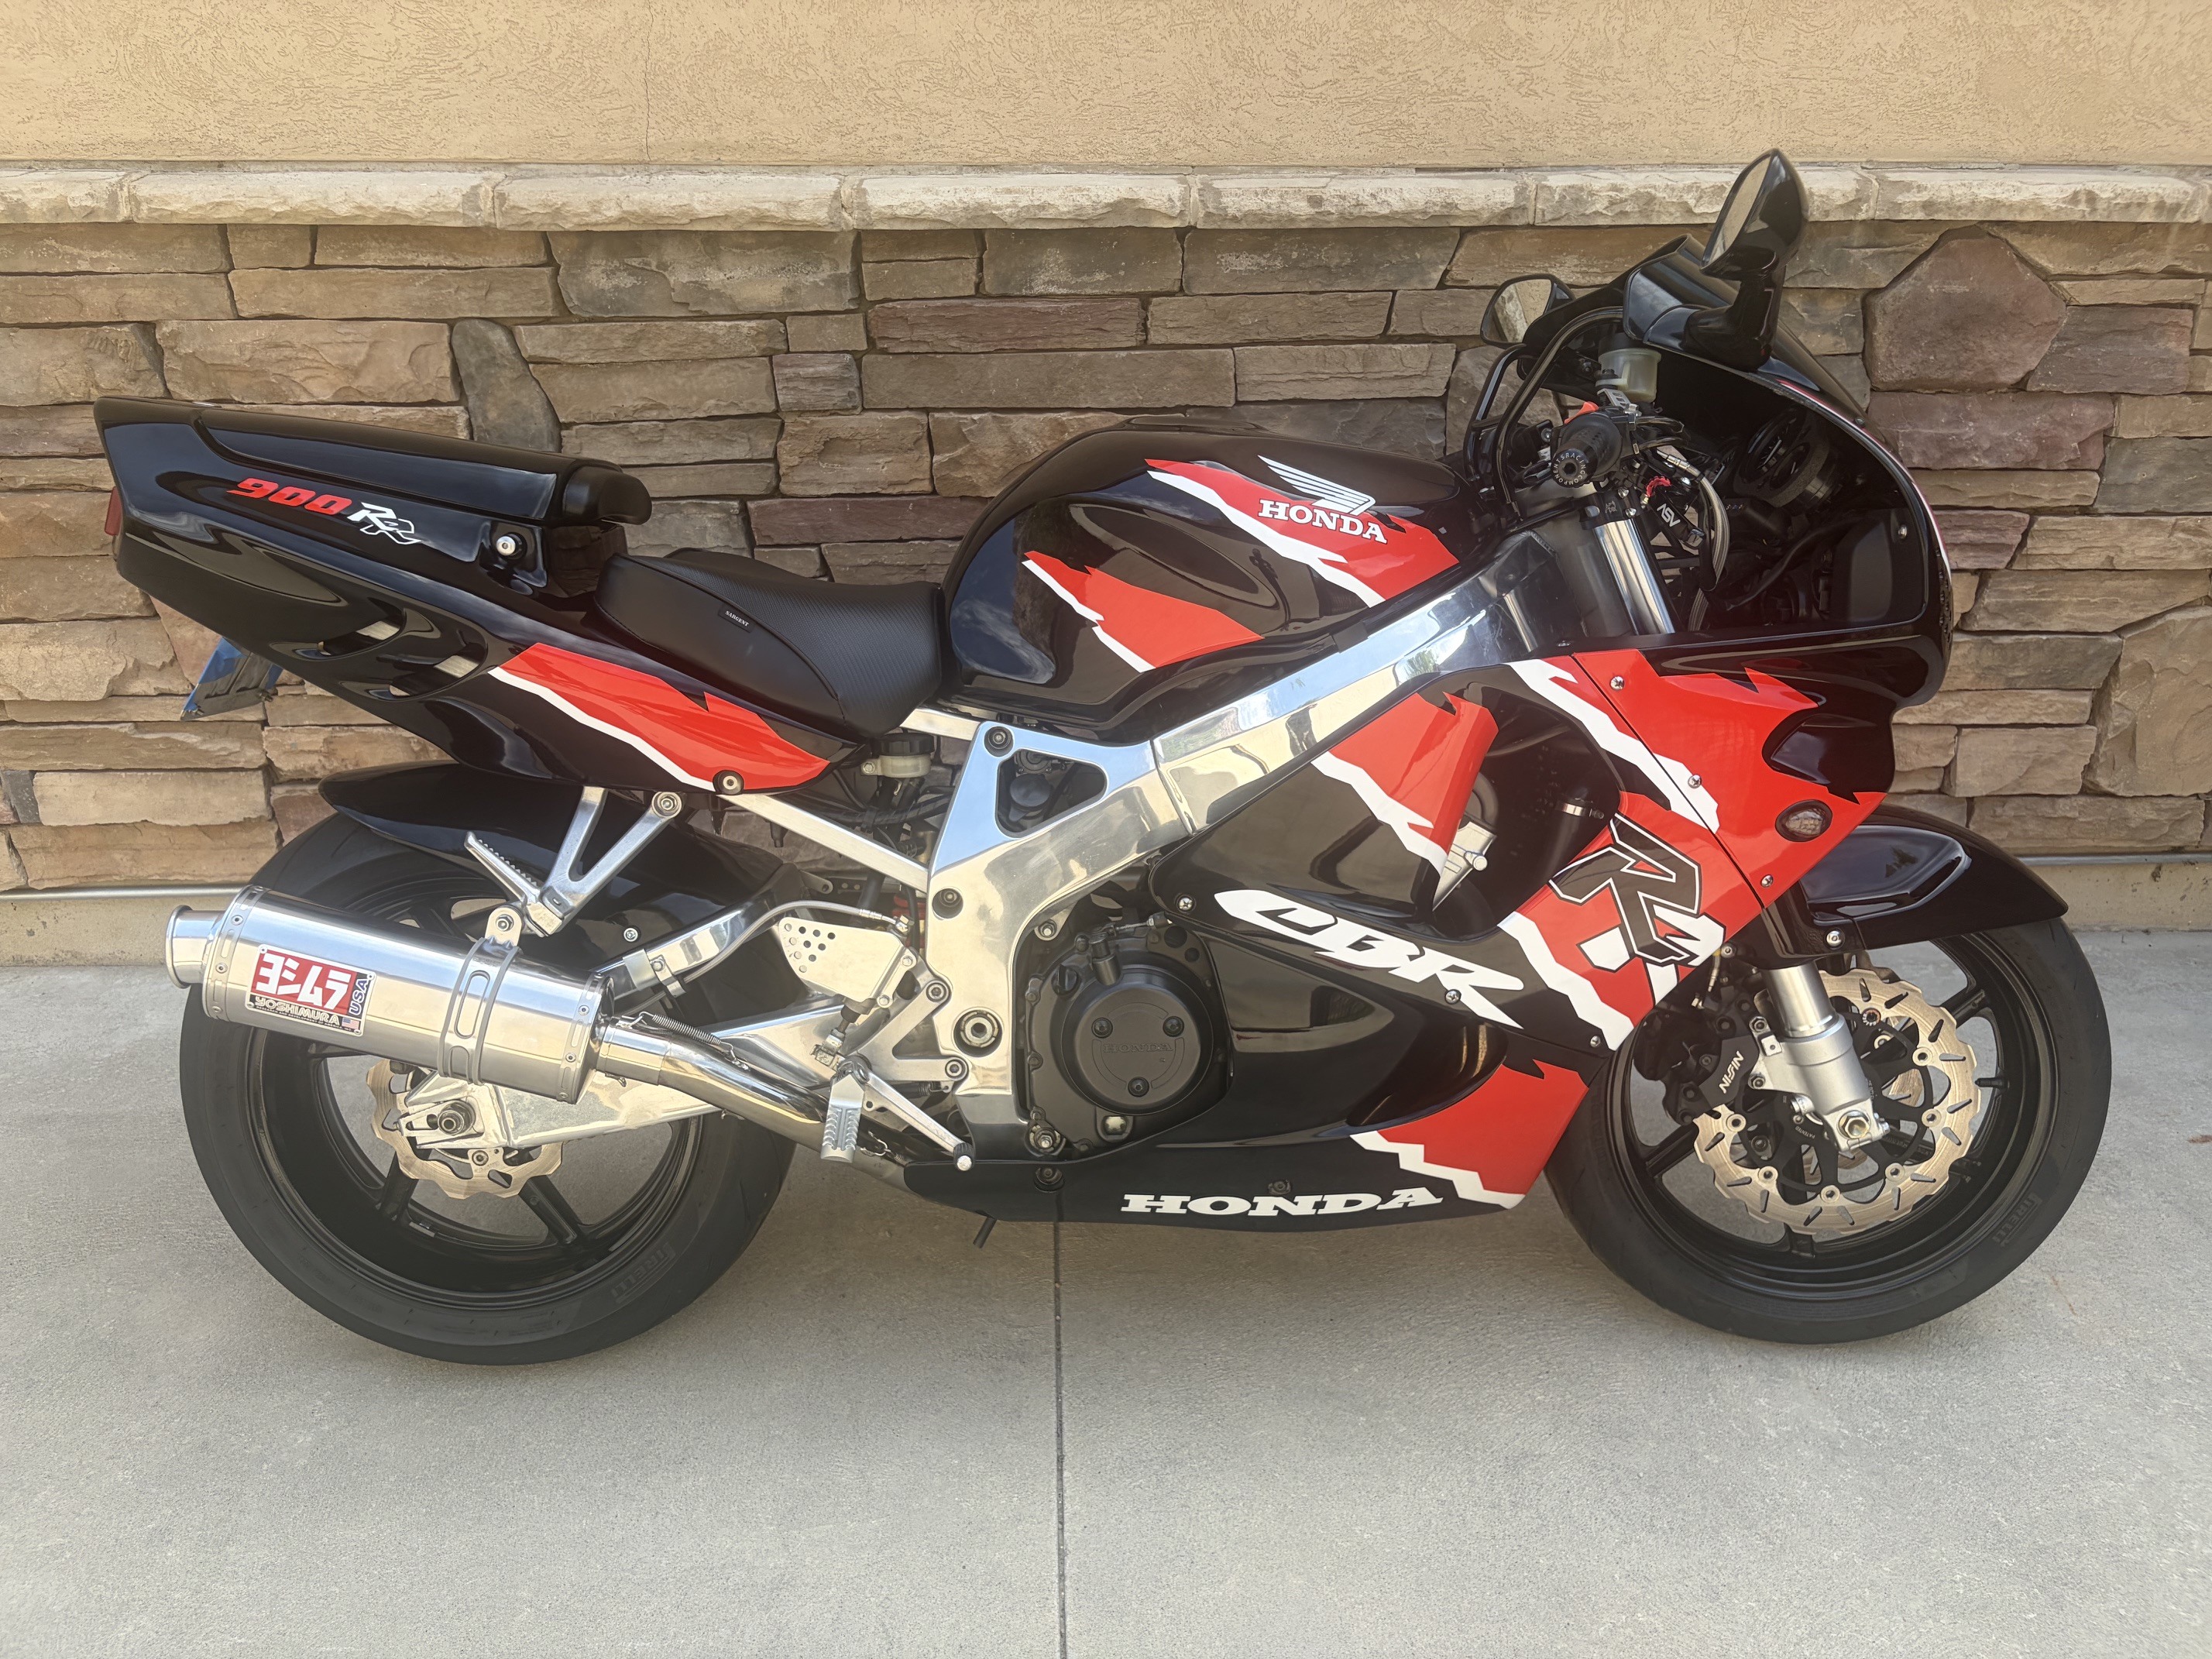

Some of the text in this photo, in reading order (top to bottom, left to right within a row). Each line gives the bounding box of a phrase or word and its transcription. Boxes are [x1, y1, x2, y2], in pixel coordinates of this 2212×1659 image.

[226, 477, 352, 516] 900
[1657, 503, 1681, 527] ASV
[1258, 498, 1388, 544] HONDA
[725, 610, 750, 627] SARGENT
[1214, 889, 1524, 1029] CBR
[256, 953, 352, 1010] ヨシムラ
[349, 978, 369, 1016] USA
[255, 996, 340, 1025] YOSHIMURA
[1102, 1042, 1174, 1053] HONDA
[1121, 1187, 1444, 1217] HONDA
[1991, 1192, 2043, 1248] PIRELLI
[610, 1241, 677, 1304] PIRELLI
